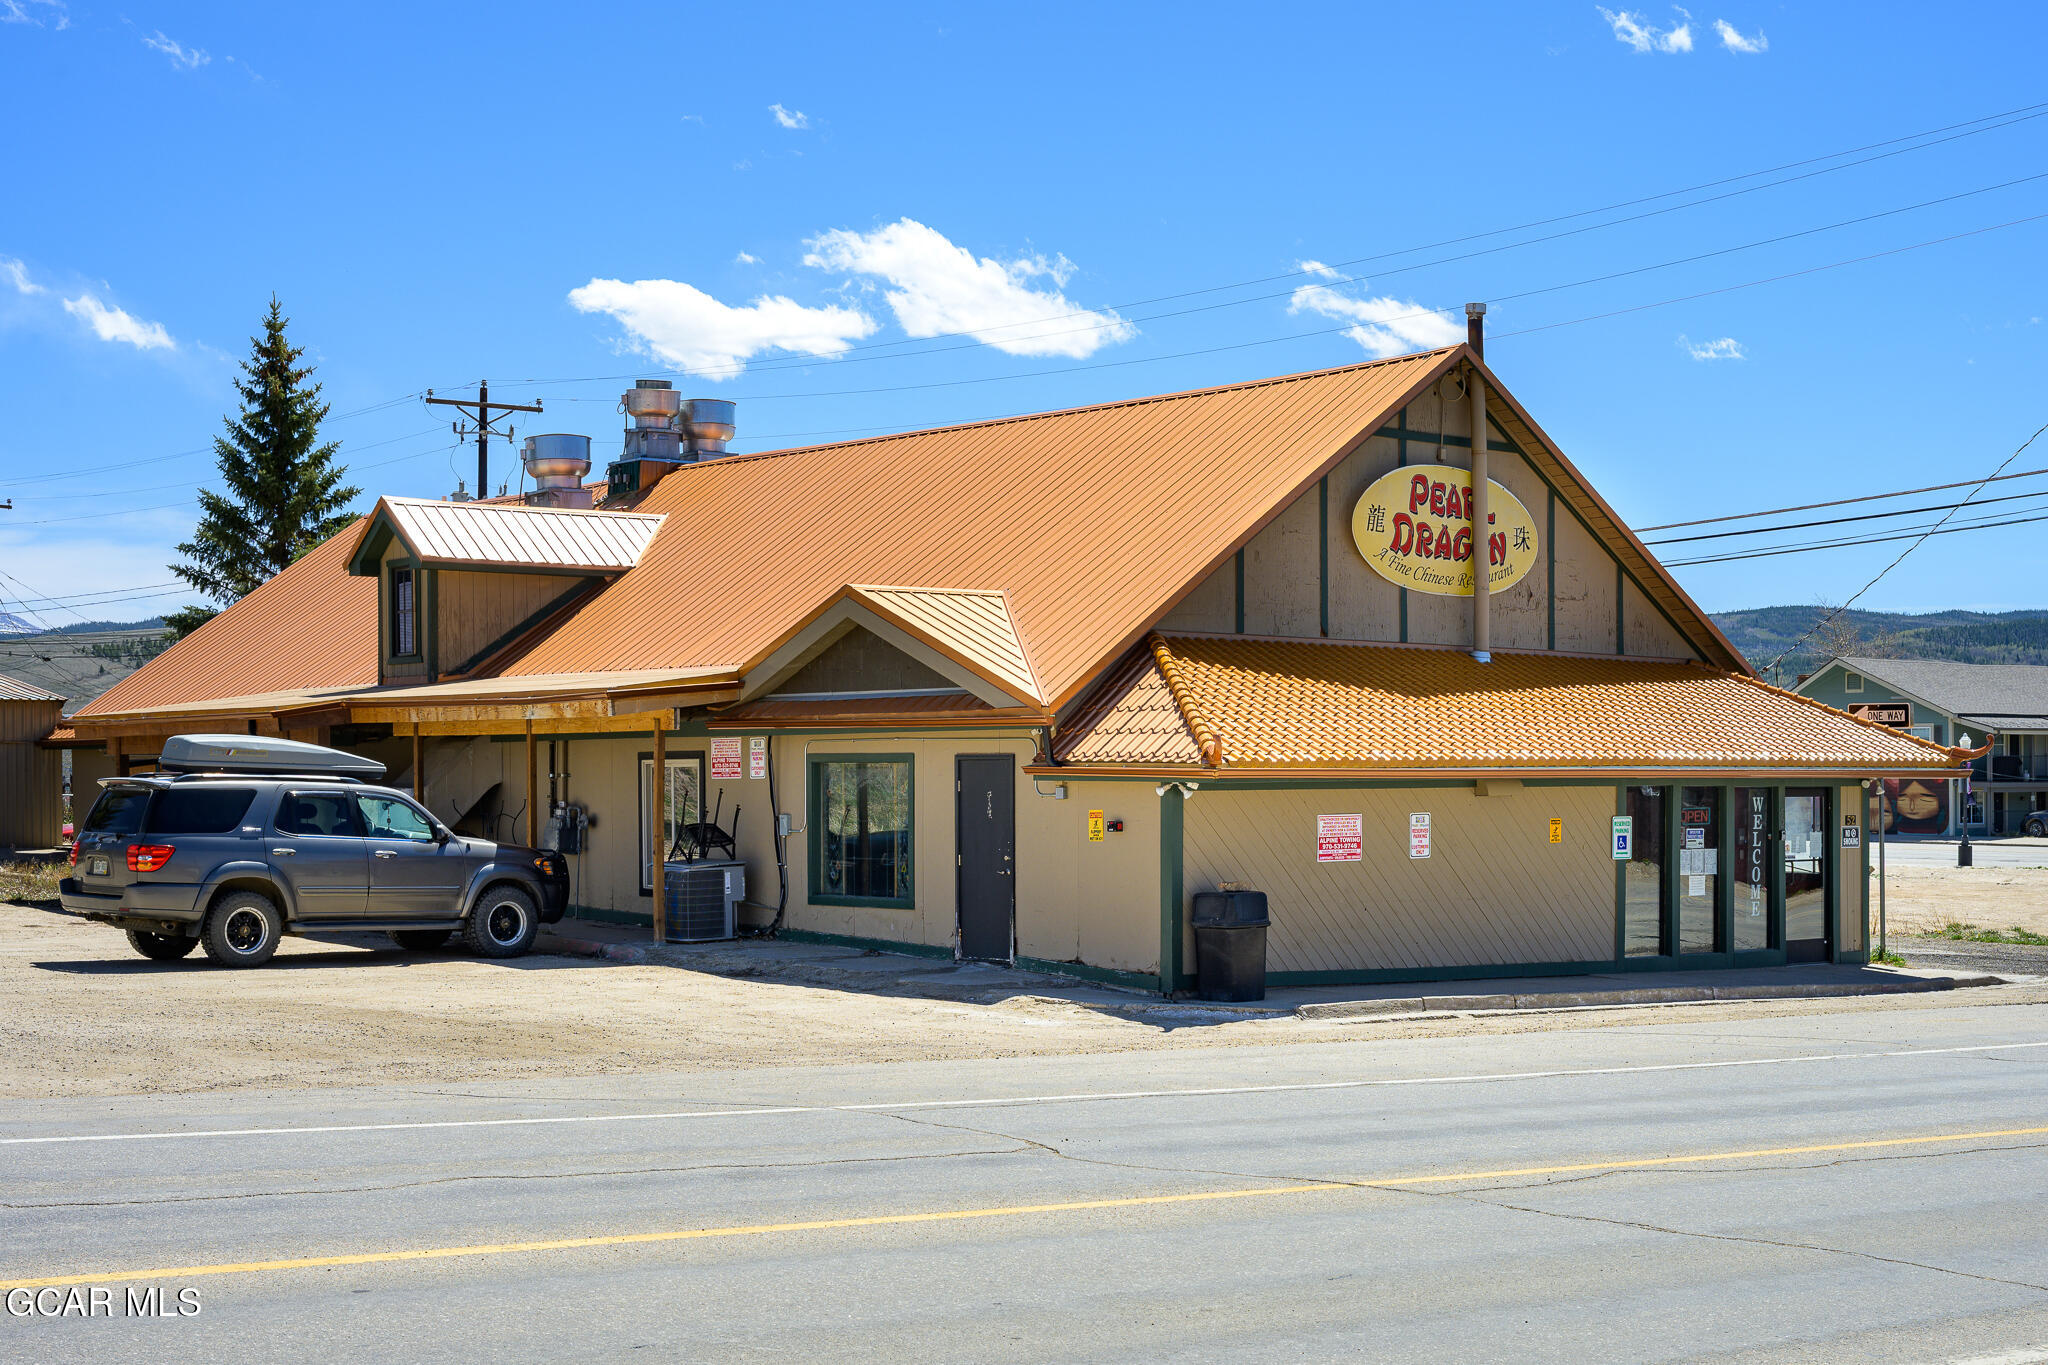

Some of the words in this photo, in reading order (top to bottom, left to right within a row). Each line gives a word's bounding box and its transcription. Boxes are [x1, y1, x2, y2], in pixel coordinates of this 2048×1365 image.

[1409, 474, 1496, 525] PEAR
[1367, 504, 1386, 533] 龍
[1389, 512, 1507, 567] DRAGN
[1512, 525, 1531, 553] 珠
[1373, 547, 1388, 561] A
[1389, 555, 1411, 576] Fine
[1412, 565, 1455, 587] Chinese
[1457, 562, 1515, 589] Resurant
[1867, 711, 1884, 721] ONE
[1887, 711, 1904, 721] WAY
[1681, 809, 1708, 823] OPEN
[1846, 815, 1856, 826] 52
[1843, 837, 1859, 846] SMOKING
[1750, 796, 1764, 917] WELCOME
